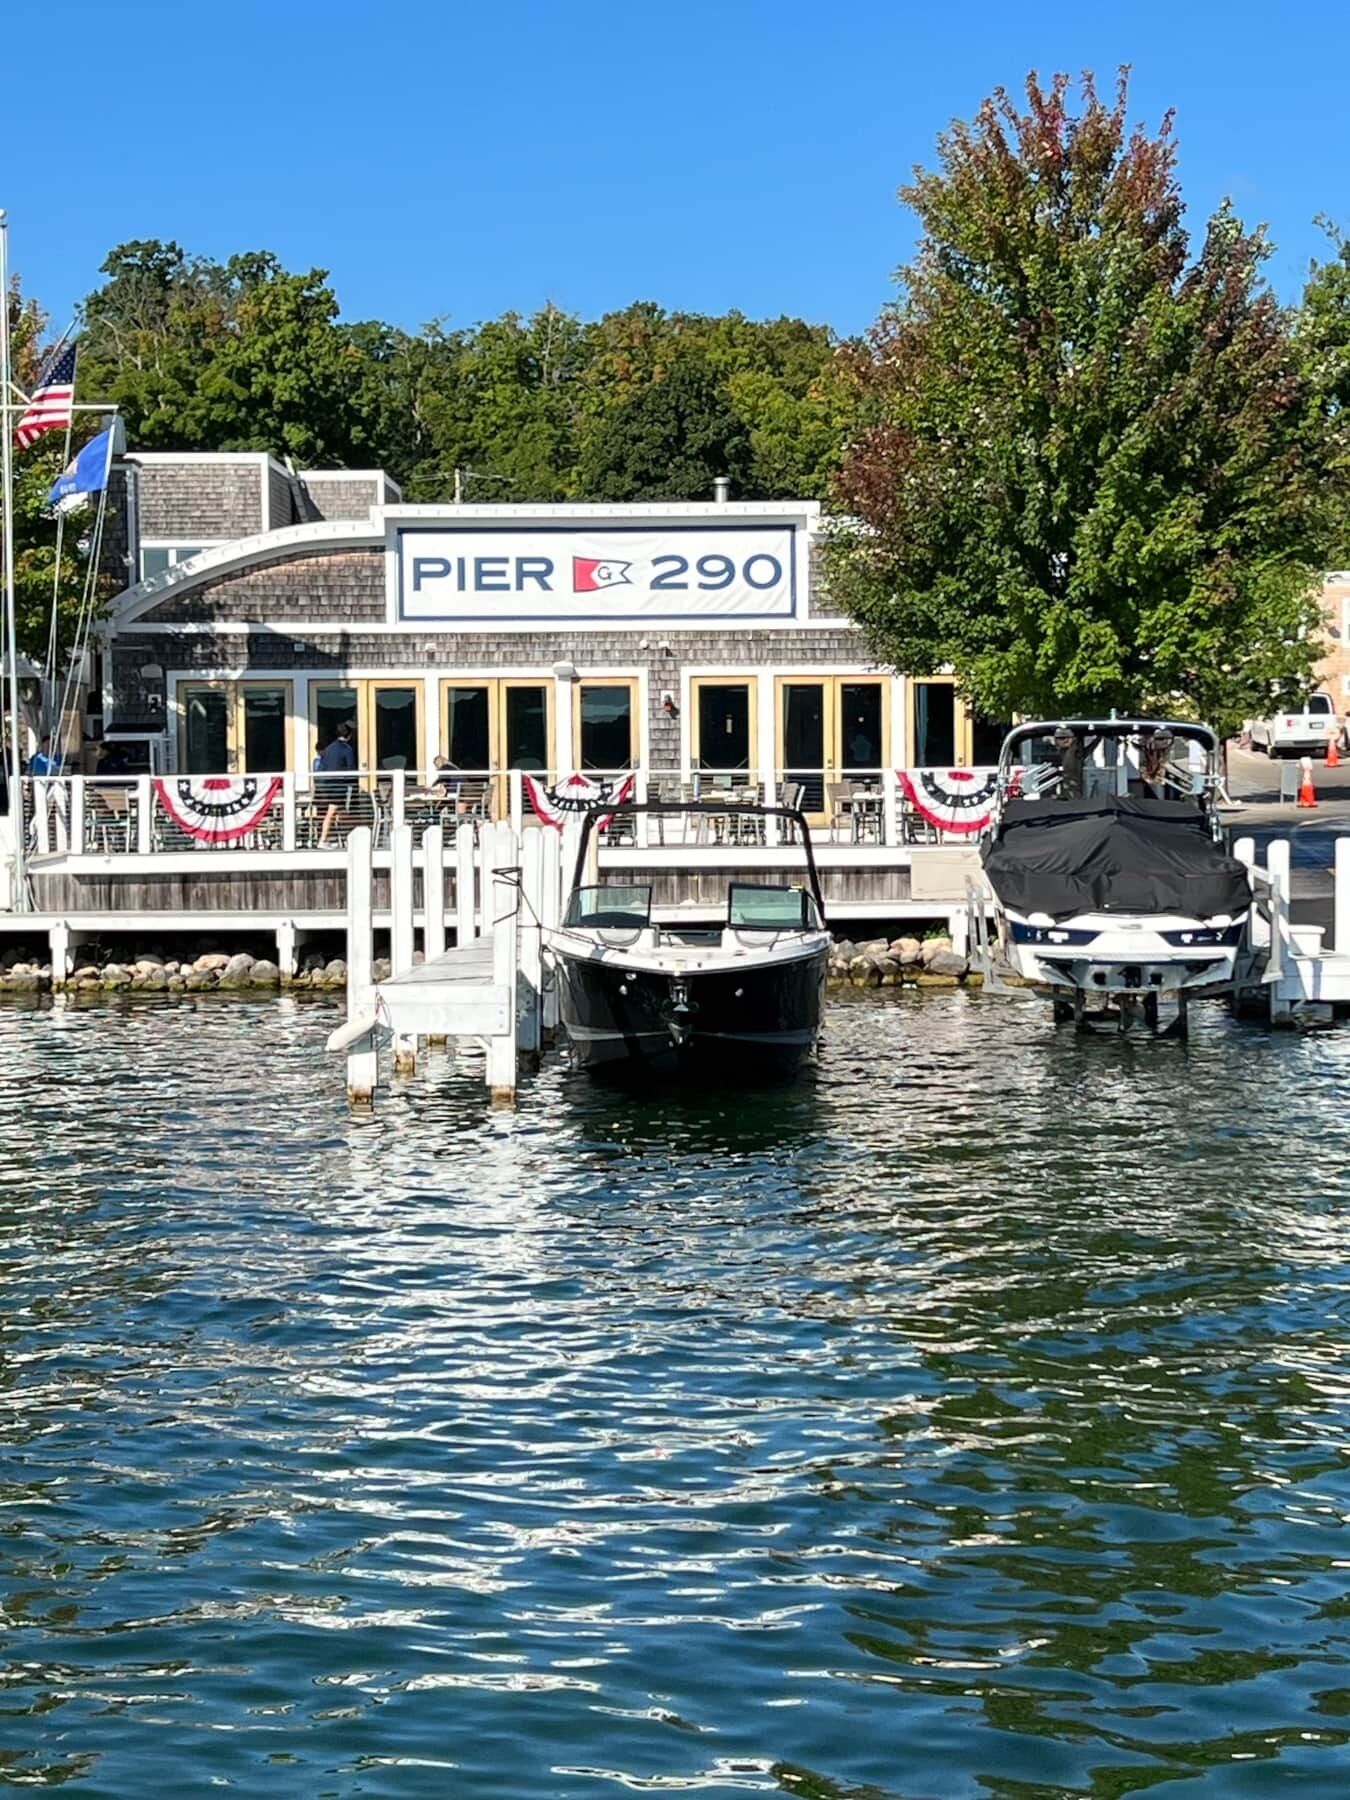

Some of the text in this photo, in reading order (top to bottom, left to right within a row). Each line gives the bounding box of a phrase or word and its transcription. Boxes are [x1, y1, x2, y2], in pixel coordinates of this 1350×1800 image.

[412, 553, 783, 592] PIER G 290
